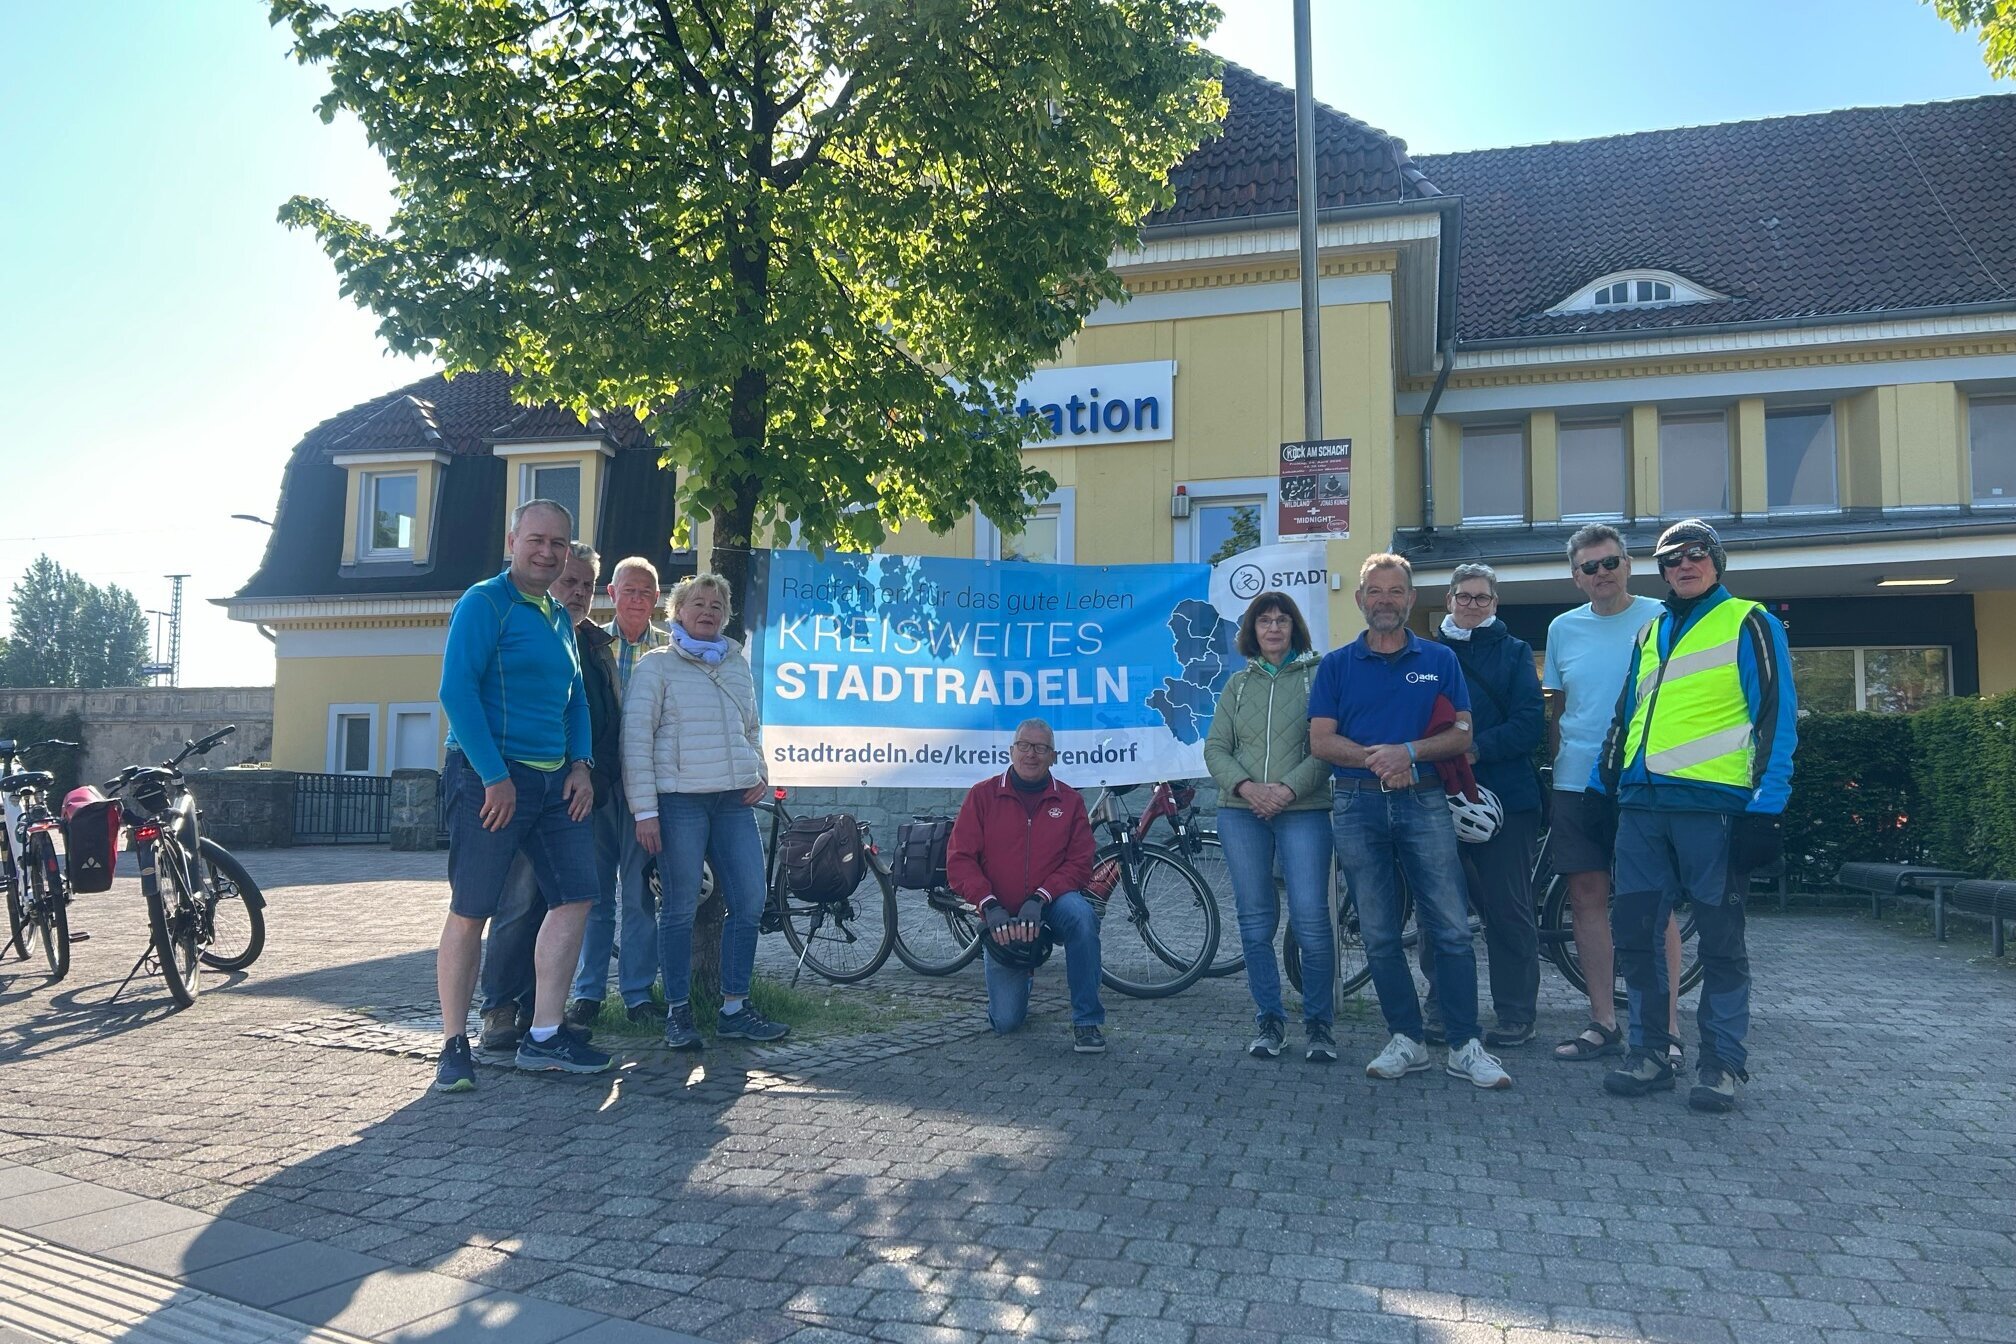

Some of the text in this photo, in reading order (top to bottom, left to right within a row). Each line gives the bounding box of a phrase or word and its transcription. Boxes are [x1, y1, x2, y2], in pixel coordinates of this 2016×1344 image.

[1306, 446, 1318, 458] AM
[1318, 444, 1349, 457] SCHACHT
[782, 577, 1133, 616] Radfahren für das gute Leben
[779, 612, 1104, 658] KREISWEITES
[775, 662, 1129, 706] STADTRADELN
[774, 742, 1138, 765] stadtradeln.de/kreisrendorf
